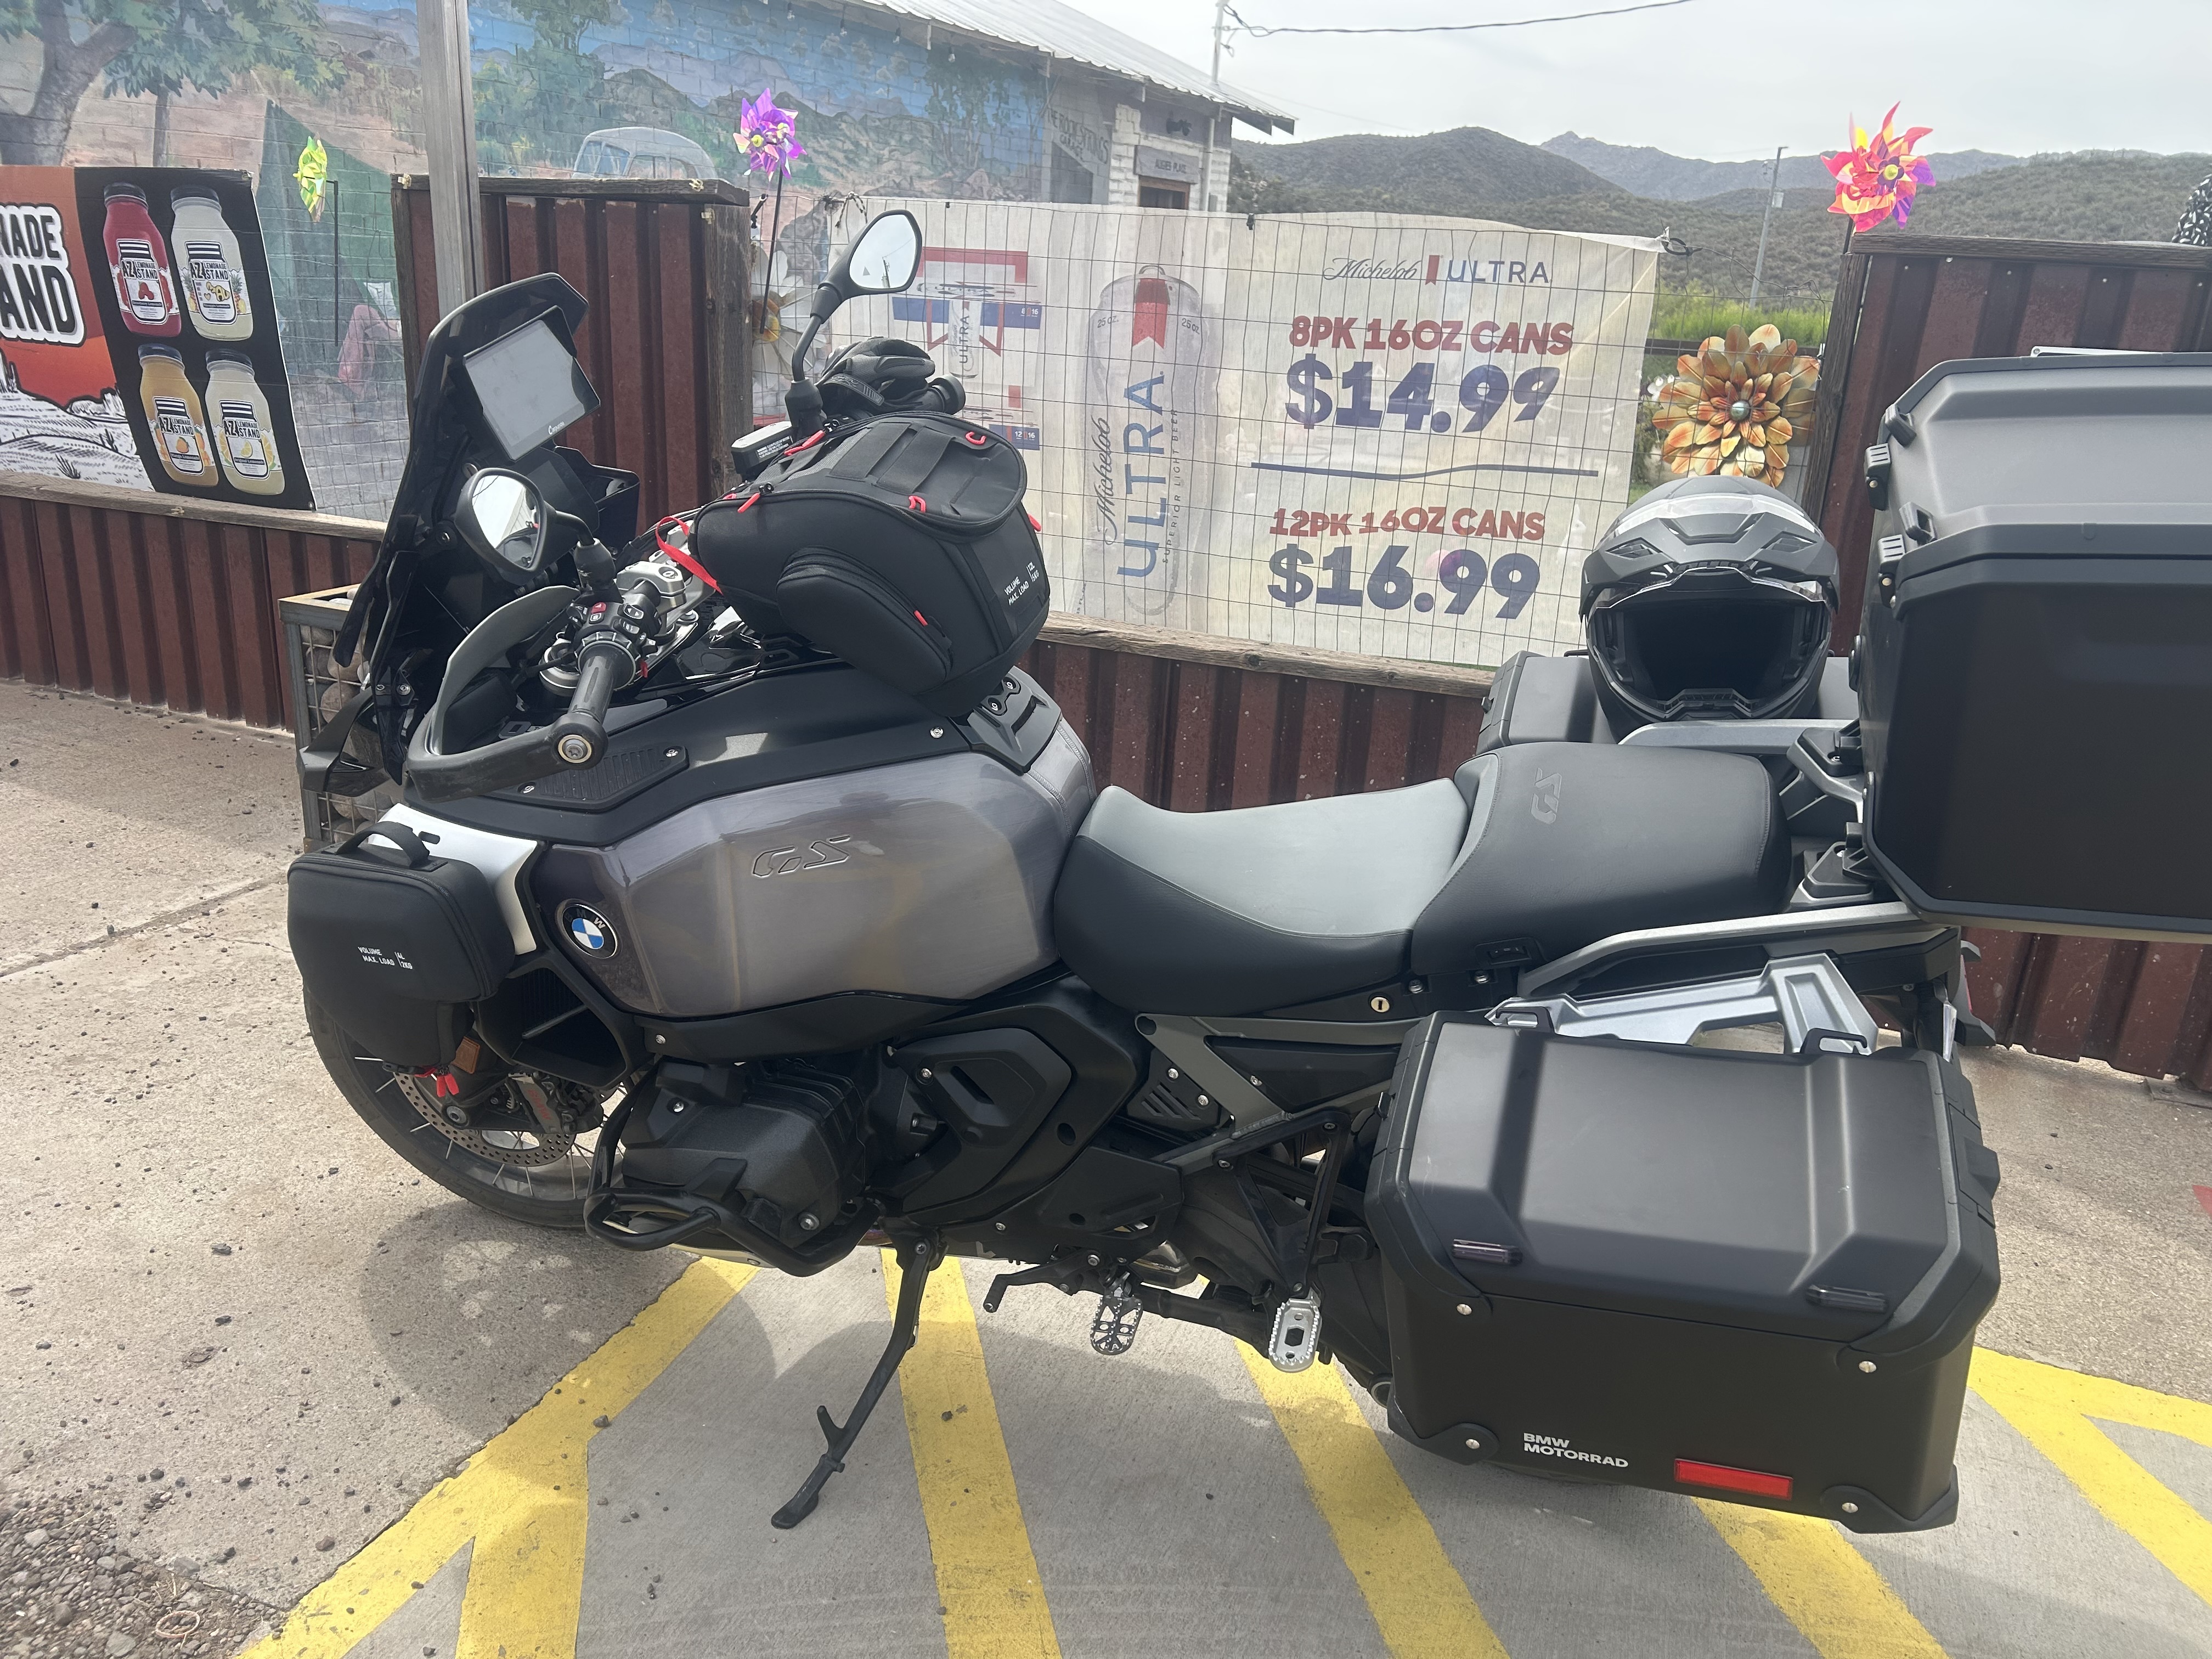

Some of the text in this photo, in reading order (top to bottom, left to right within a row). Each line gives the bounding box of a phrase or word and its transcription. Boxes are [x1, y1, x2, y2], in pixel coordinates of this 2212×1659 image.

[137, 268, 158, 280] STAND
[206, 269, 229, 280] STAND
[1323, 257, 1550, 284] Michelob ULTRA
[1097, 317, 1106, 328] 25
[1181, 318, 1192, 329] 25
[1289, 315, 1574, 356] 8PK 16OZ CANS
[959, 315, 969, 364] ULTRA
[1285, 353, 1560, 433] $14.99
[173, 424, 194, 436] STAND
[239, 428, 261, 439] STAND
[1091, 415, 1118, 546] Michelob
[1116, 374, 1166, 578] ULTRA
[1162, 409, 1181, 563] SUPERIOR LIGHT BEER
[1269, 506, 1546, 540] 12PK 16OZ CANS
[1004, 576, 1020, 595] VOLUME
[1018, 580, 1029, 596] LOAD
[1031, 569, 1039, 582] 5KG
[1267, 543, 1541, 620] $16.99
[752, 834, 851, 878] GS
[357, 946, 382, 956] VOLUME
[379, 957, 395, 966] LOAD
[1523, 1432, 1570, 1448] BMW
[1524, 1442, 1629, 1468] MOTORRAD
